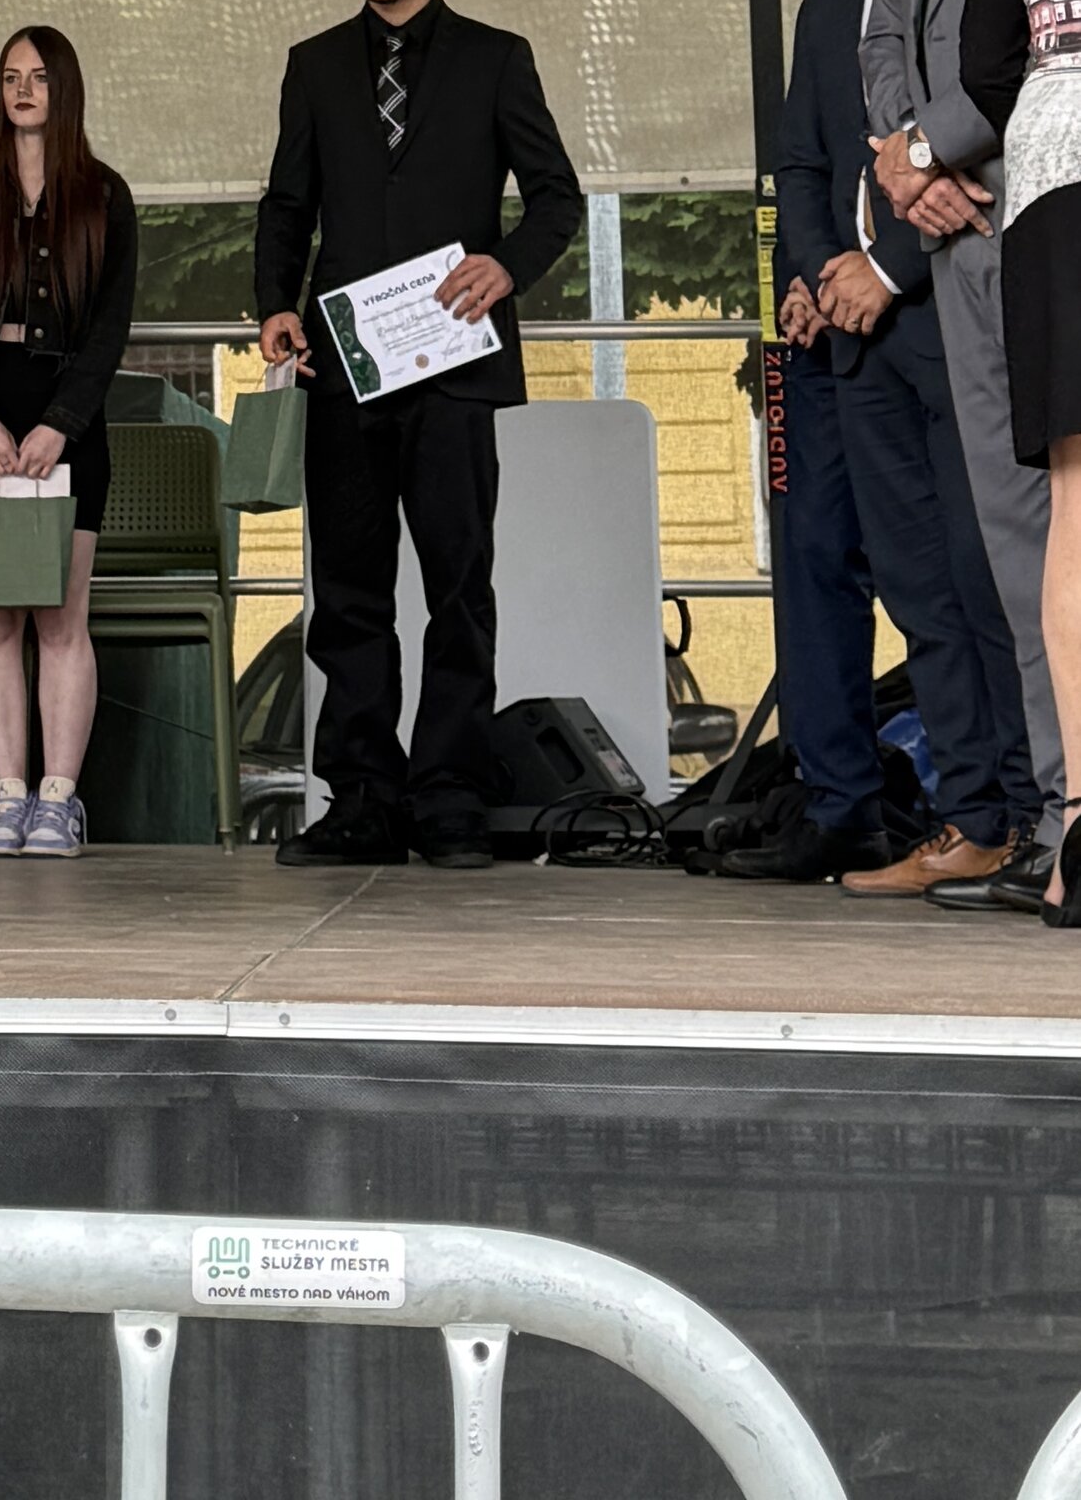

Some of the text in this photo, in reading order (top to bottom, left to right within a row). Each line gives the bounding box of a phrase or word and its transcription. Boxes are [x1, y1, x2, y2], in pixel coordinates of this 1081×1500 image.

[261, 1237, 359, 1252] TECHNICKÉ
[260, 1253, 390, 1273] SLUŽBY MESTA
[208, 1284, 390, 1302] NOVÉ MESTO NAD VÁHOM
